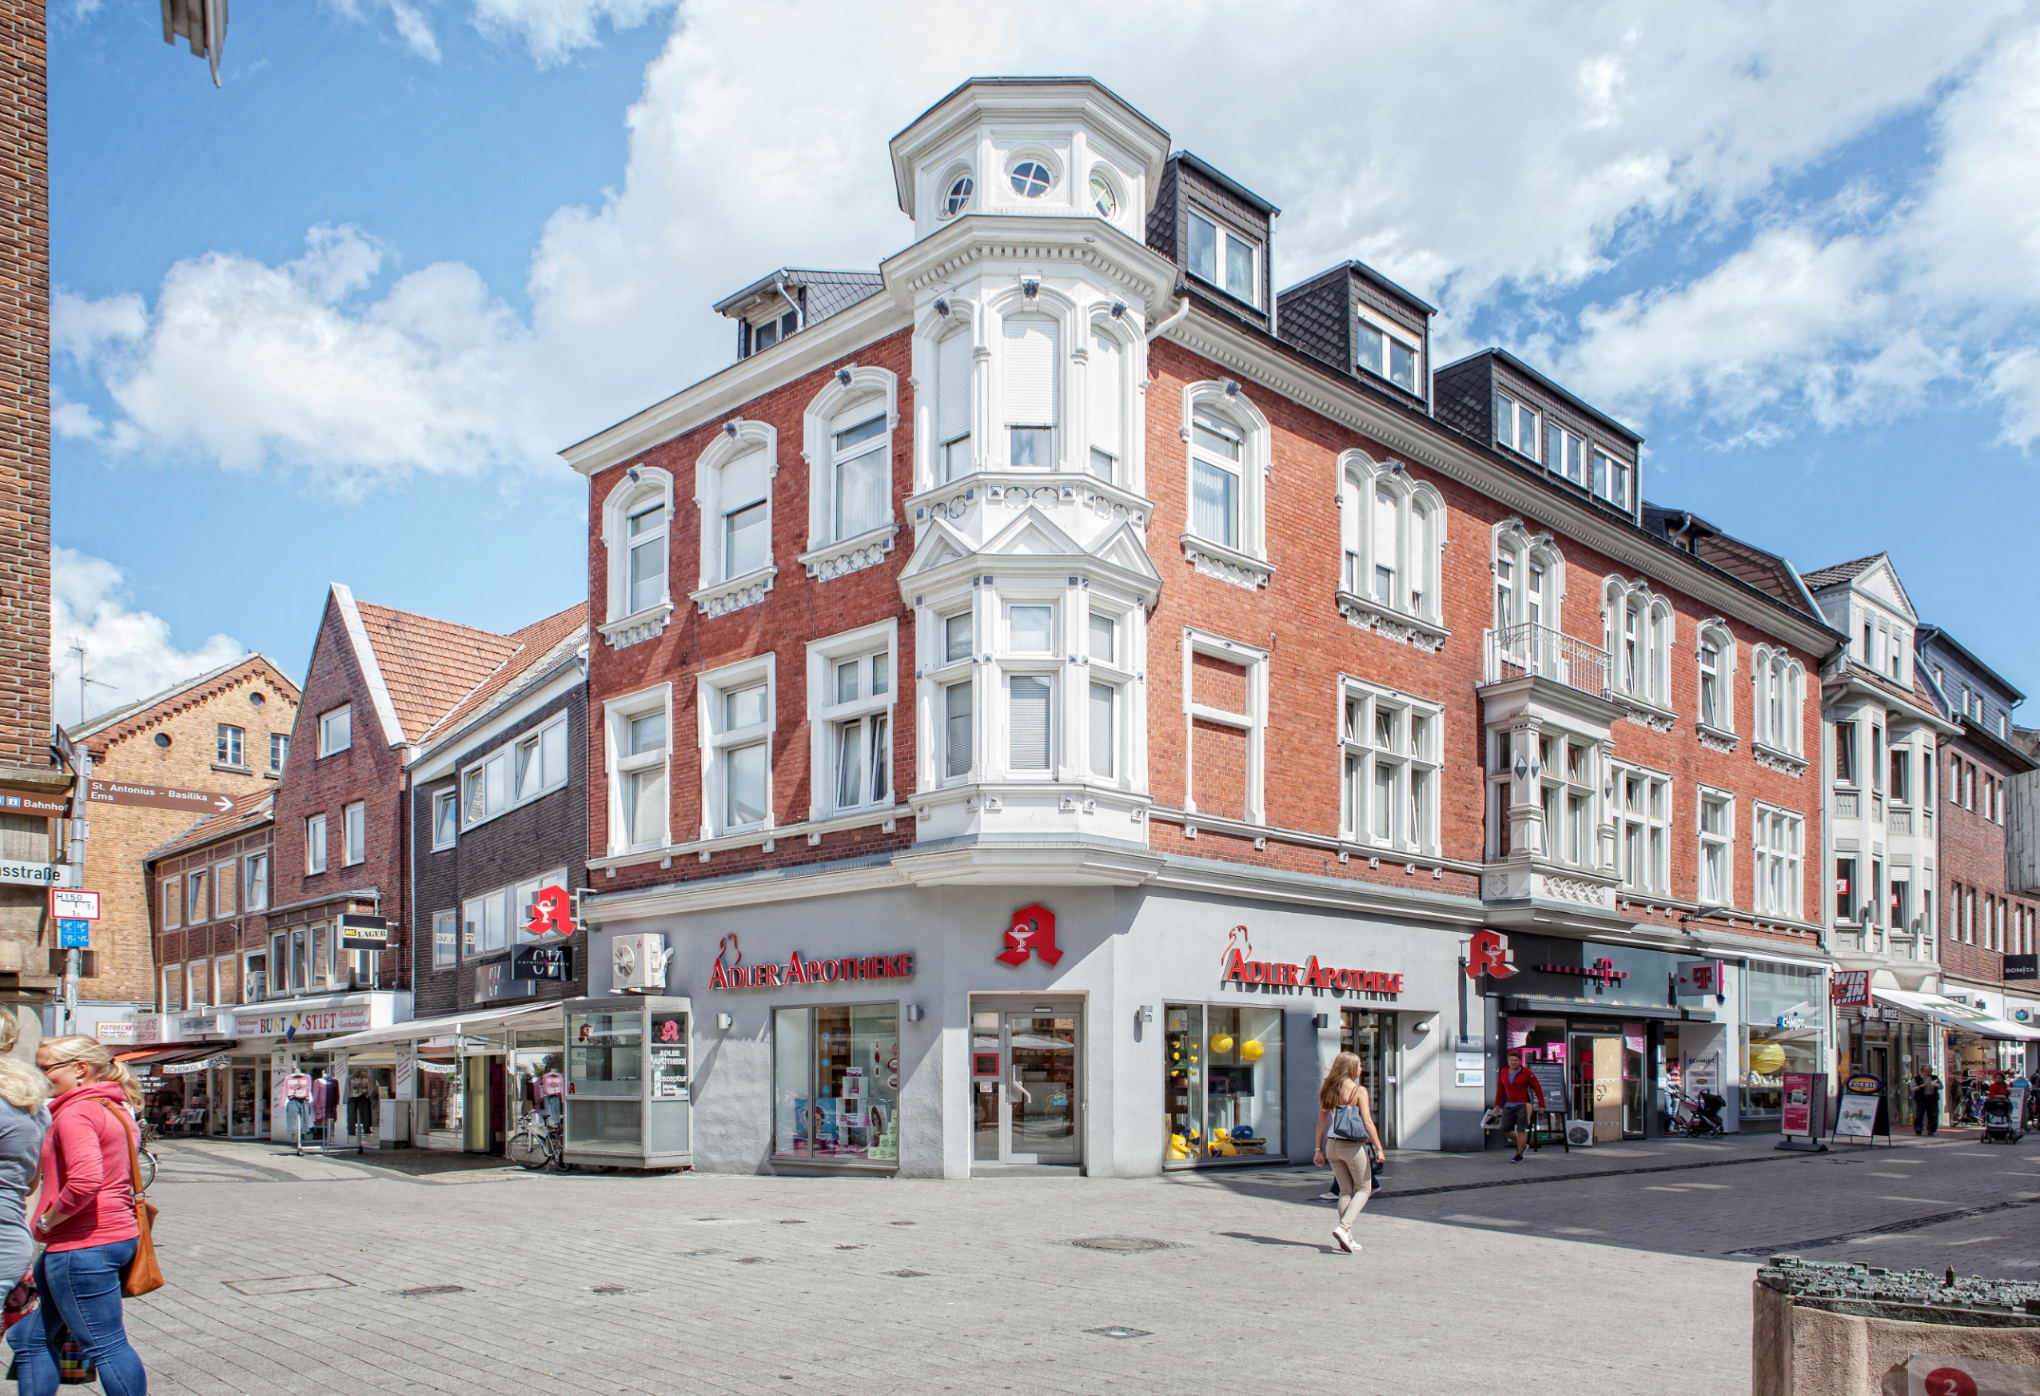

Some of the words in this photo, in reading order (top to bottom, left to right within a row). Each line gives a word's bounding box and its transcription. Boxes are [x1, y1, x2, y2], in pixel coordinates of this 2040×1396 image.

[91, 792, 114, 801] Ems
[92, 782, 105, 790] St.
[110, 784, 155, 796] Antonius
[168, 790, 208, 802] Basilika
[23, 800, 69, 812] Bahnhof
[0, 865, 61, 881] sstraße
[357, 930, 387, 938] LAGER
[708, 958, 778, 990] ADLER
[784, 951, 911, 984] APOTHEKE
[1227, 948, 1299, 986] ADLER
[1304, 955, 1404, 993] APOTHEKE
[1834, 972, 1867, 985] WIR
[1846, 985, 1866, 997] IN
[1835, 995, 1867, 1004] RHEINE
[260, 1017, 287, 1034] BUNT
[1943, 1378, 1958, 1396] 2
